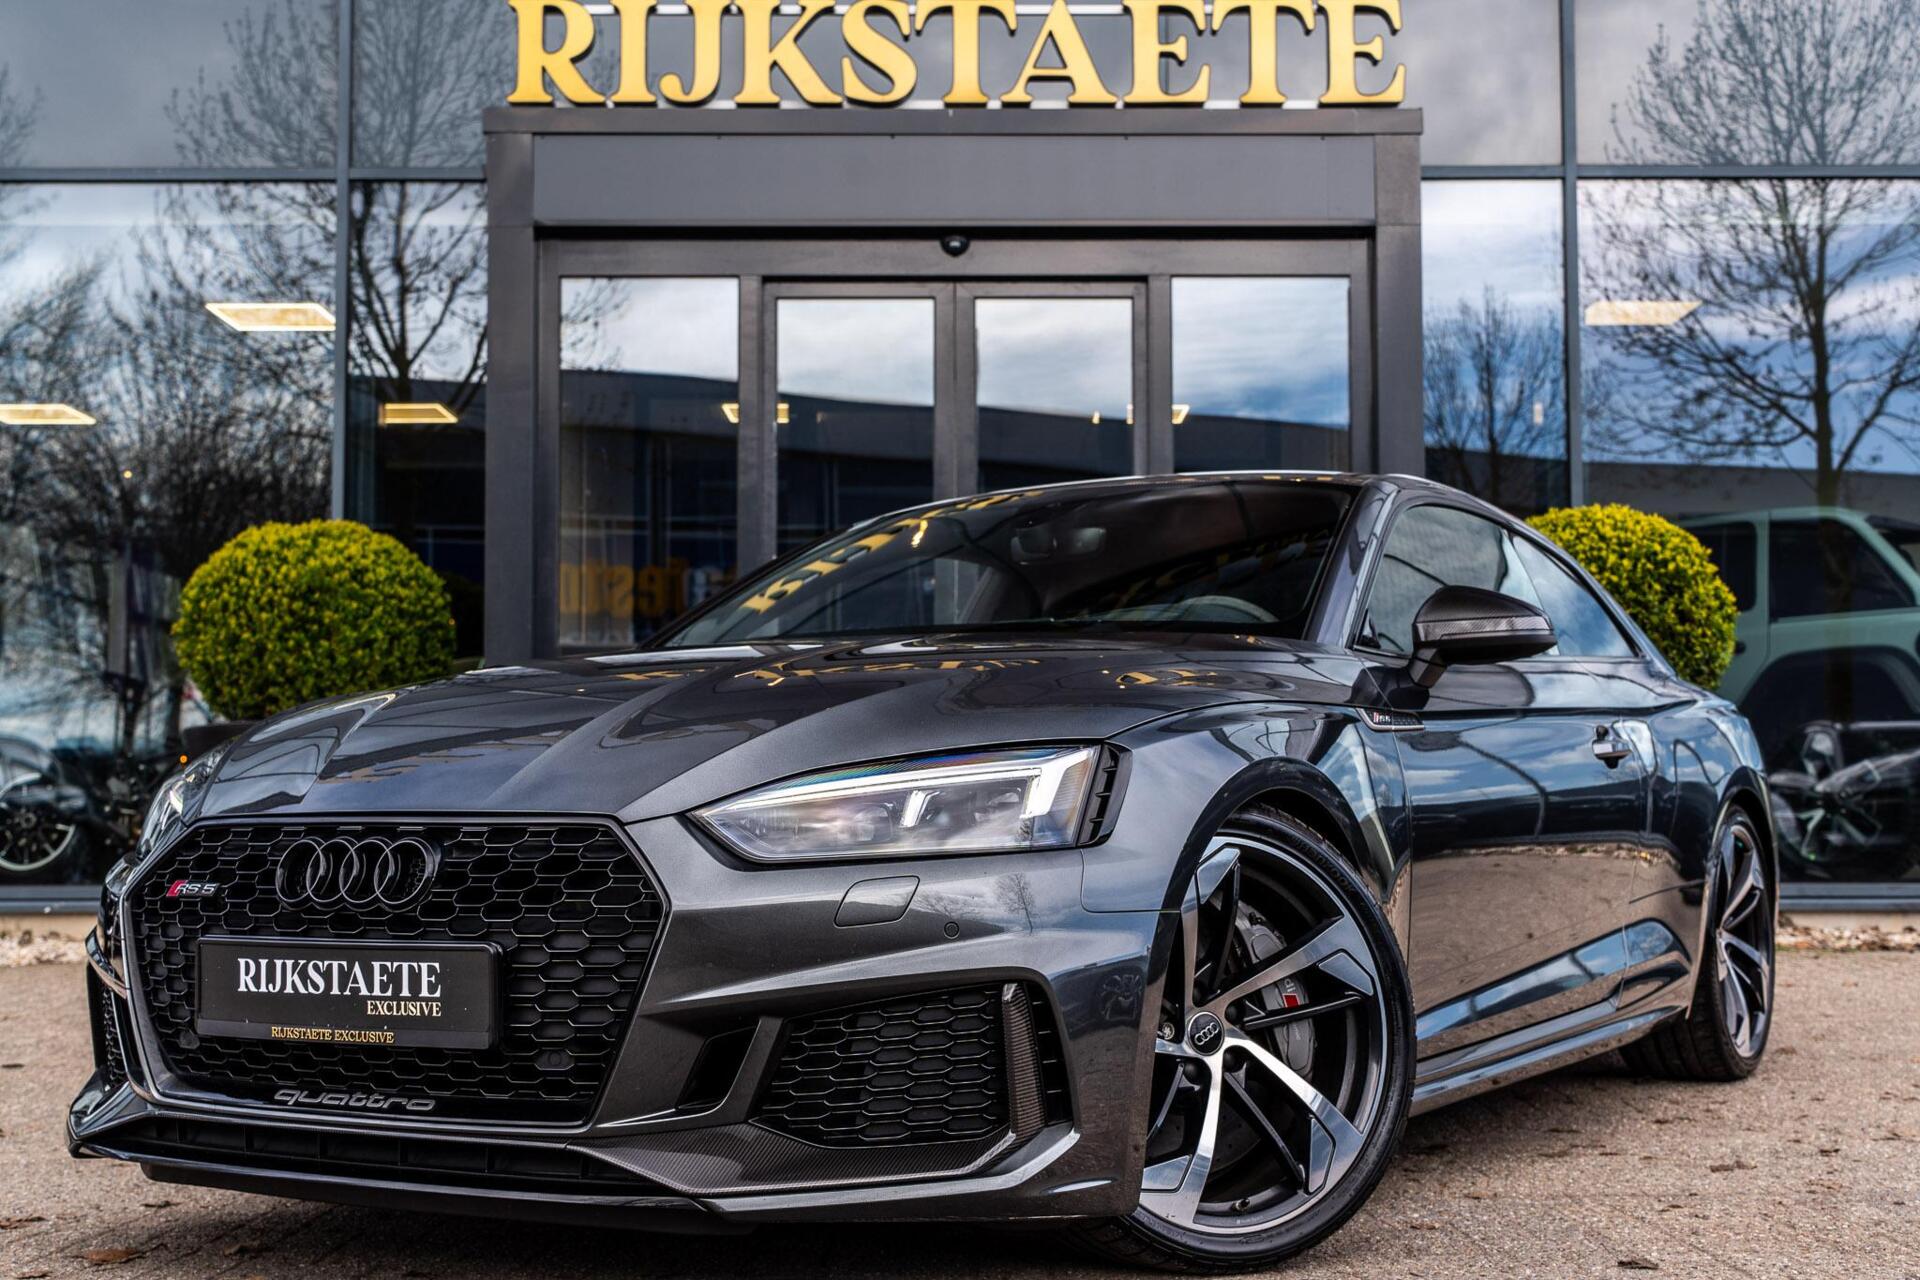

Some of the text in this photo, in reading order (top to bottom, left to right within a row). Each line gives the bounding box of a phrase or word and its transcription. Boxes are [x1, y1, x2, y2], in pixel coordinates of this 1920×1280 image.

[506, 0, 1406, 105] RIJKSTAETE
[237, 957, 442, 998] RIJKSTAETE
[366, 1000, 442, 1018] EXCLUSIVE
[271, 1025, 395, 1045] RIJKSTAETE EXCLUSIVE
[274, 1088, 436, 1111] quattro
